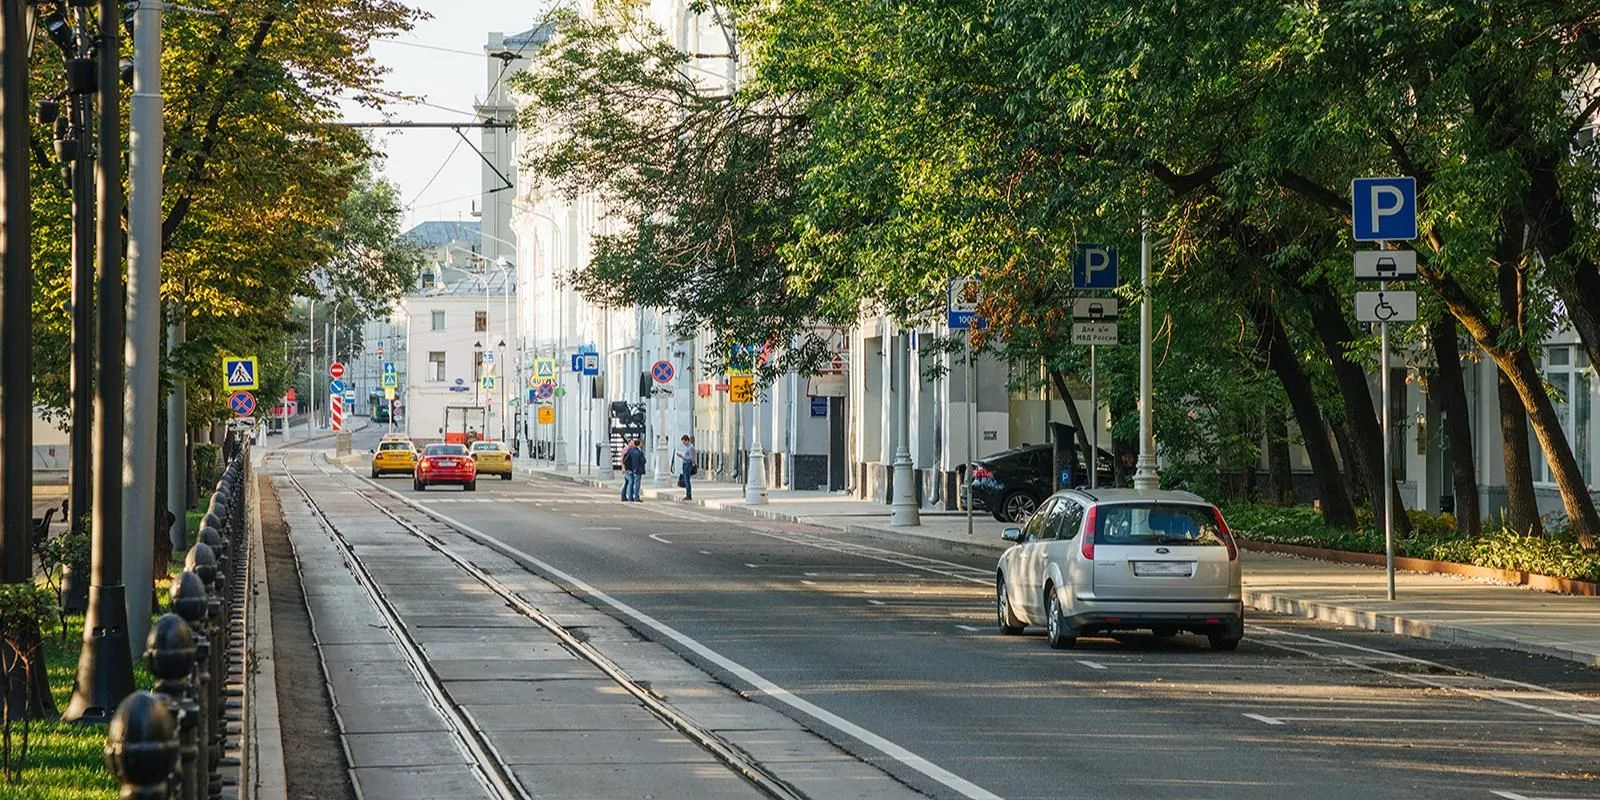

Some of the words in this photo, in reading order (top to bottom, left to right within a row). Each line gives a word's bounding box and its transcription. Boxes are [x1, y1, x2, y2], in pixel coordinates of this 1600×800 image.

[1371, 185, 1404, 233] P
[1085, 248, 1110, 283] P
[1062, 472, 1069, 482] P
